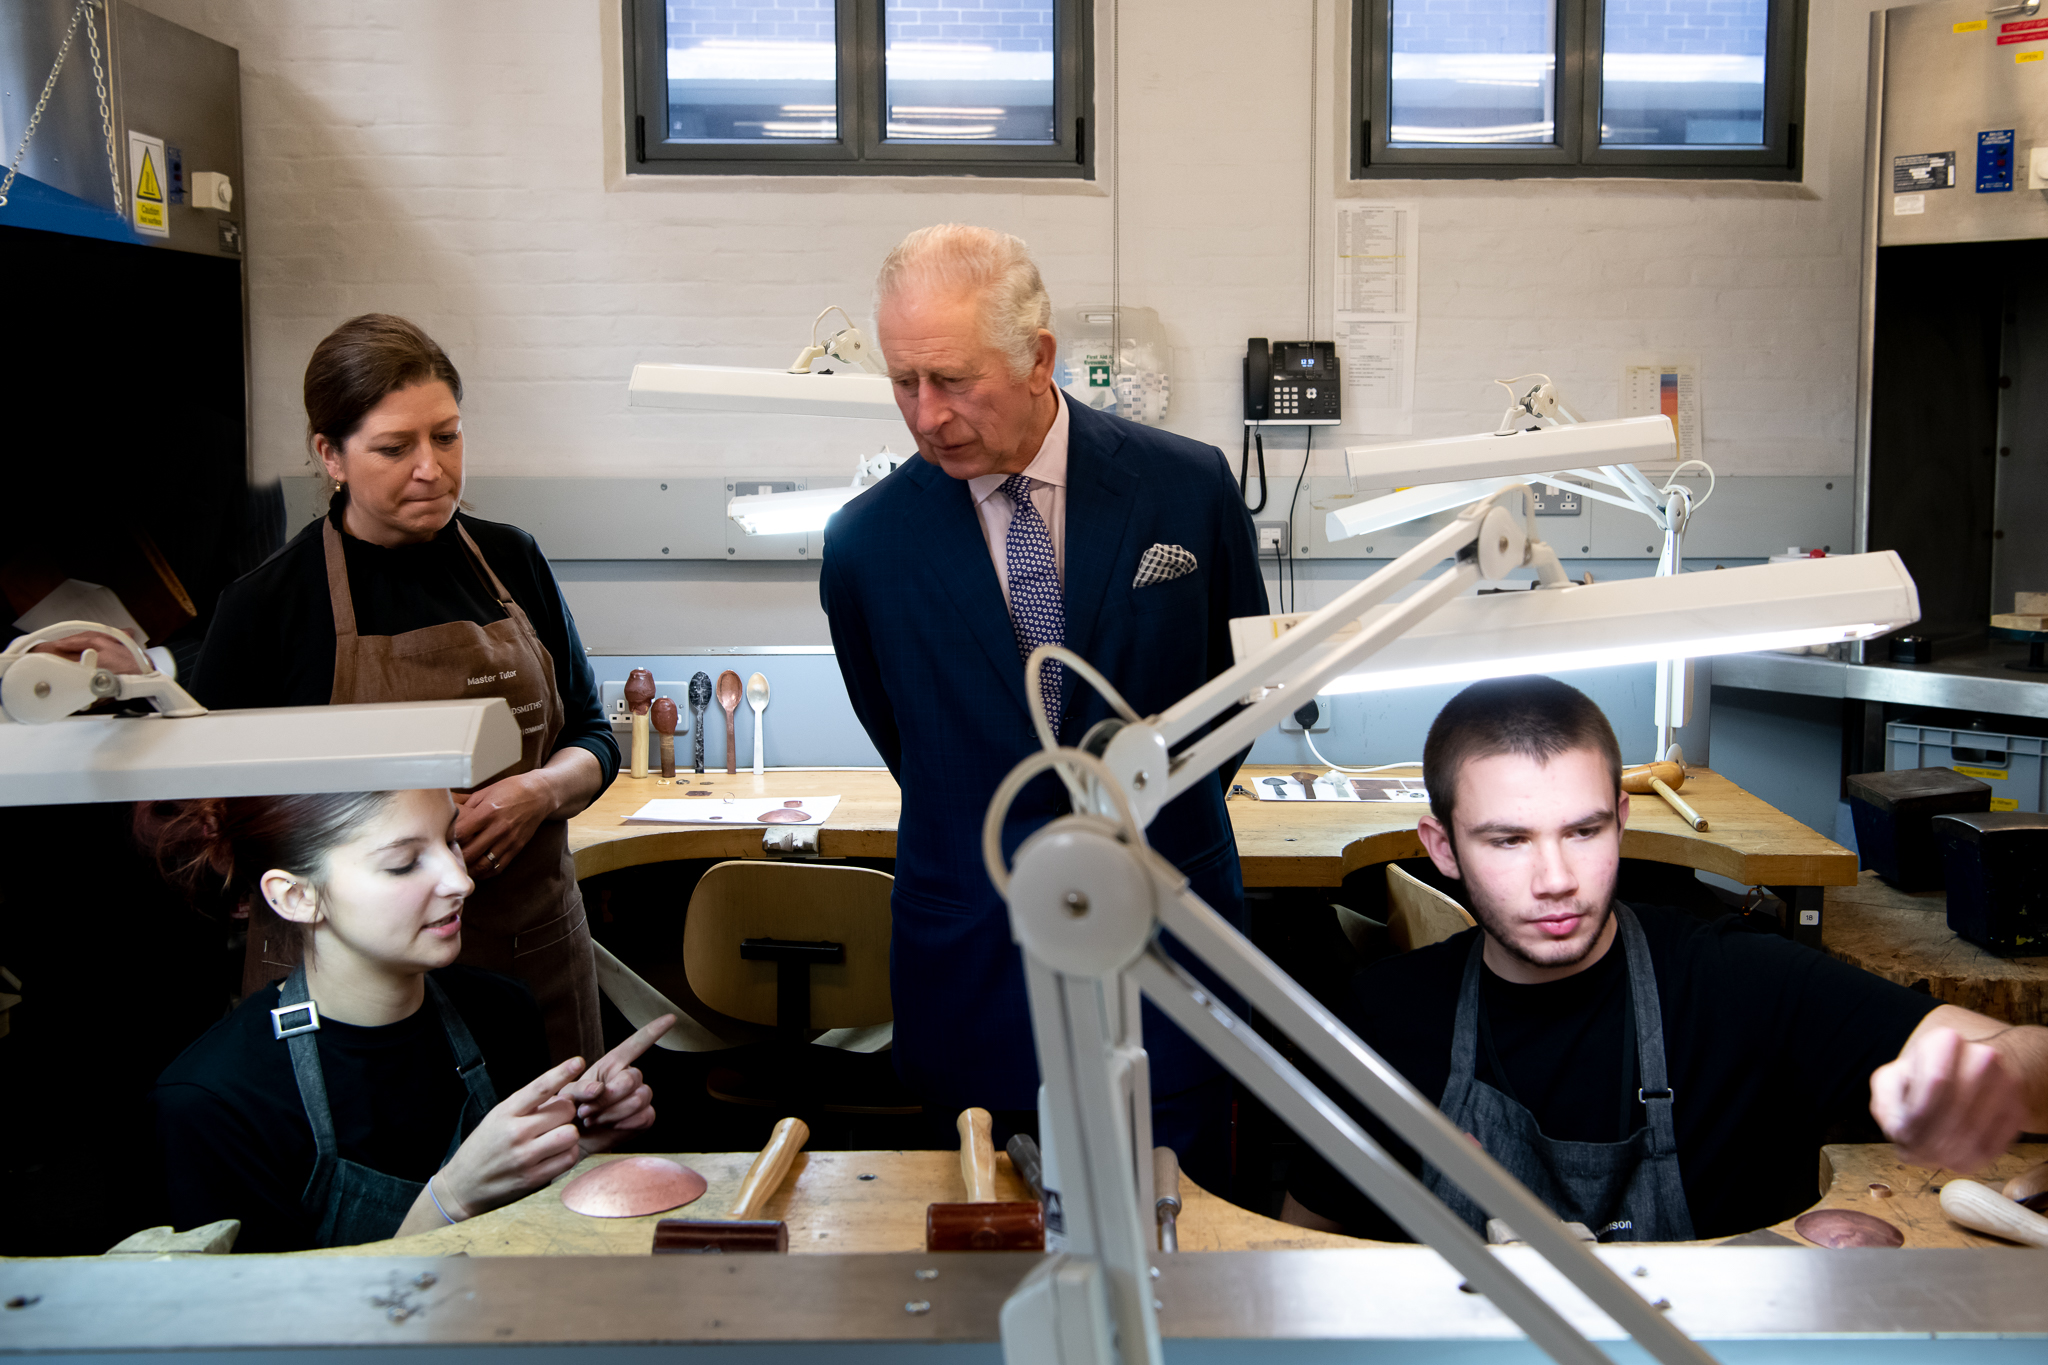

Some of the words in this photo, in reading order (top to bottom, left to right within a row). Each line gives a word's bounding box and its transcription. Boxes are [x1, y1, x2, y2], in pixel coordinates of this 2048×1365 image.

[142, 204, 160, 215] Caution
[467, 674, 496, 686] Master
[499, 669, 517, 681] Tutor
